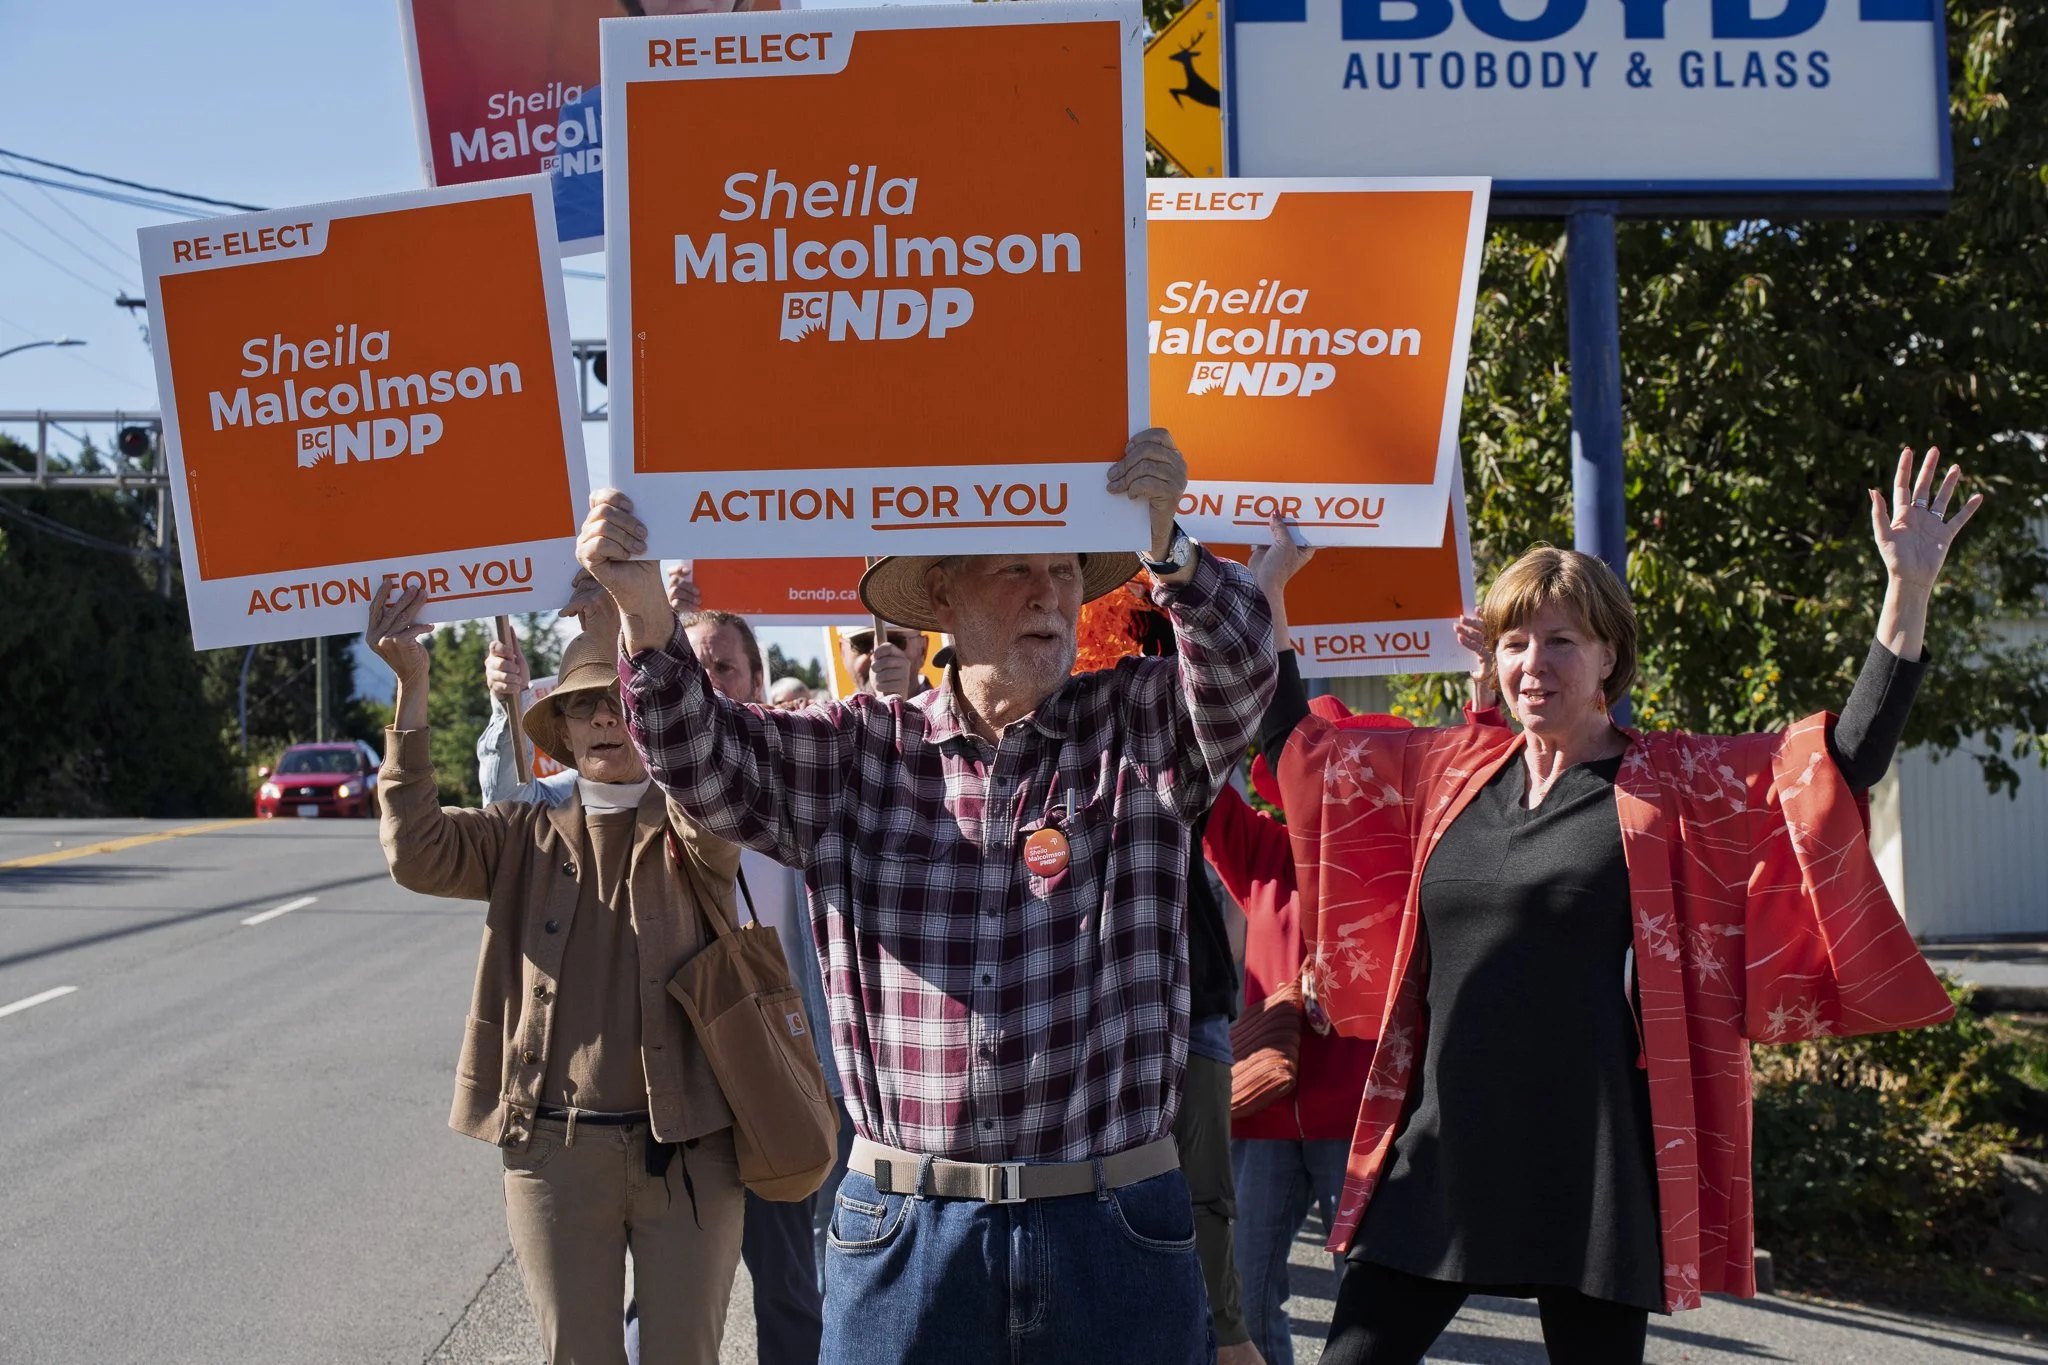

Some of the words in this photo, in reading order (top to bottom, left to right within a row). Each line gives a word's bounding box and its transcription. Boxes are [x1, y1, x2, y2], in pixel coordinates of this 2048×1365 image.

[649, 32, 832, 68] RE-ELECT
[1342, 50, 1598, 89] AUTOBODY
[1625, 51, 1653, 89] &
[1679, 50, 1831, 89] GLASS
[487, 81, 583, 119] Sheila
[450, 106, 602, 168] Malcol
[543, 157, 560, 170] BC
[562, 148, 603, 177] ND
[719, 164, 918, 221] Sheila
[1148, 192, 1263, 211] E-ELECT
[173, 223, 313, 263] RE-ELECT
[674, 224, 1081, 285] Malcolmson
[787, 297, 824, 320] BC
[828, 287, 974, 342] NDP
[1159, 278, 1308, 315] Sheila
[241, 324, 390, 378] Sheila
[209, 362, 522, 431] Malcolmson
[1197, 366, 1224, 380] BC
[1223, 362, 1336, 397] NDP
[302, 431, 328, 450] BC
[334, 413, 443, 465] NDP
[689, 487, 854, 523] ACTION
[872, 485, 959, 518] FOR
[974, 482, 1068, 516] YOU
[1234, 495, 1302, 519] FOR
[1314, 497, 1385, 520] YOU
[248, 577, 371, 616] ACTION
[459, 557, 533, 589] YOU
[788, 587, 857, 603] bcndp.ca
[1315, 634, 1367, 656] FOR
[1373, 631, 1431, 653] YOU
